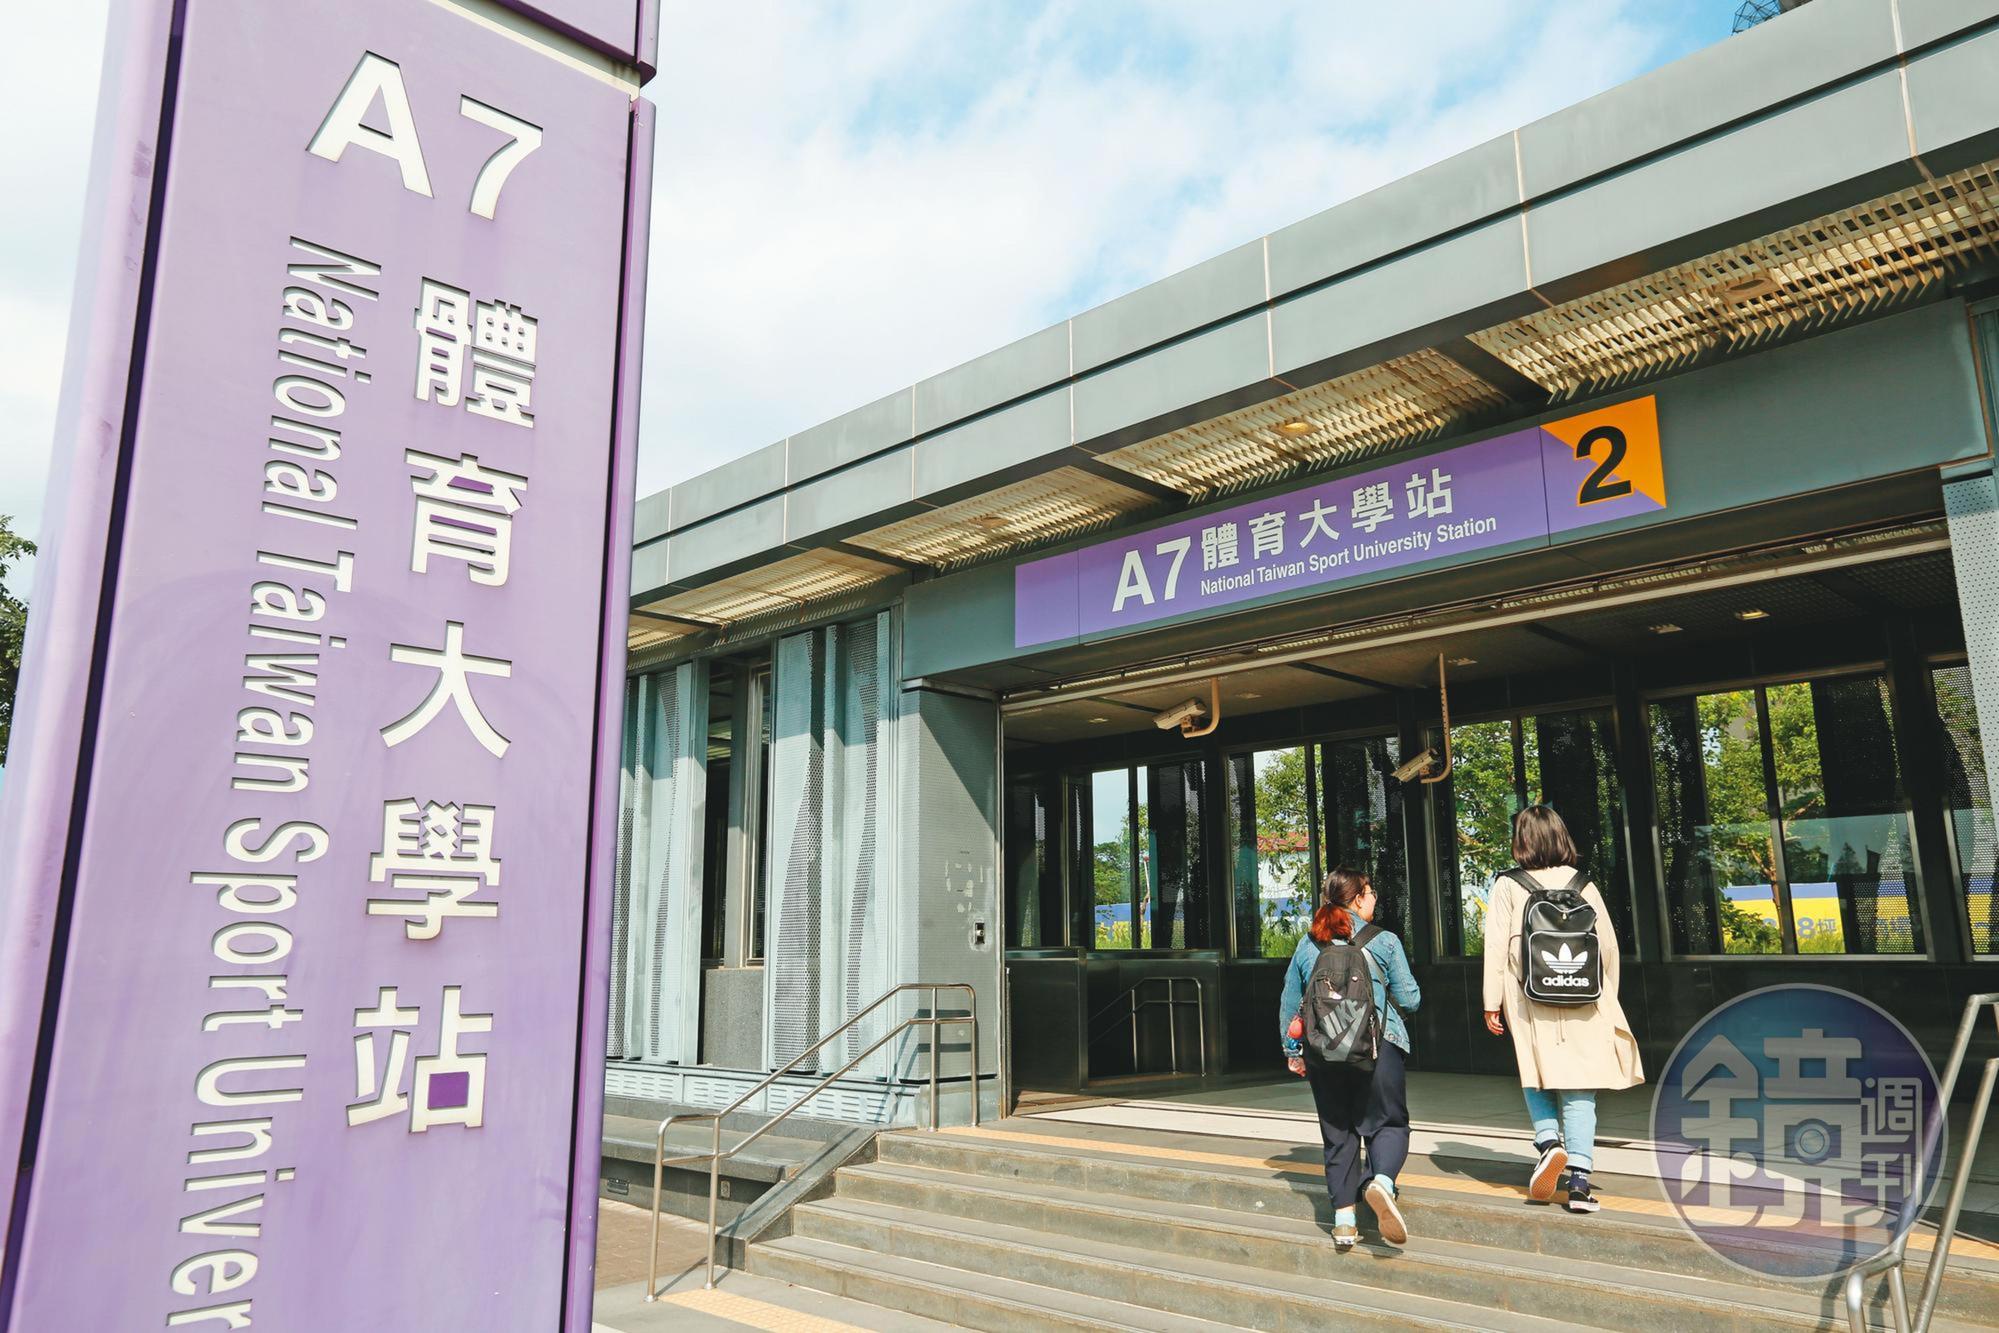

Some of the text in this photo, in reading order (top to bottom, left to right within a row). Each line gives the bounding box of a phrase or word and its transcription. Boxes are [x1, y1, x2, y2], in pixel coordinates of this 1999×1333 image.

[262, 236, 382, 530] National
[1575, 425, 1633, 505] 2
[306, 51, 543, 1133] A7 體育大學站
[1112, 468, 1454, 612] A7 體育大學站
[1201, 517, 1497, 596] National Taiwan Sport University Station
[234, 550, 355, 793] Taiwan
[189, 816, 330, 1032] Sport
[1541, 974, 1590, 987] adidas
